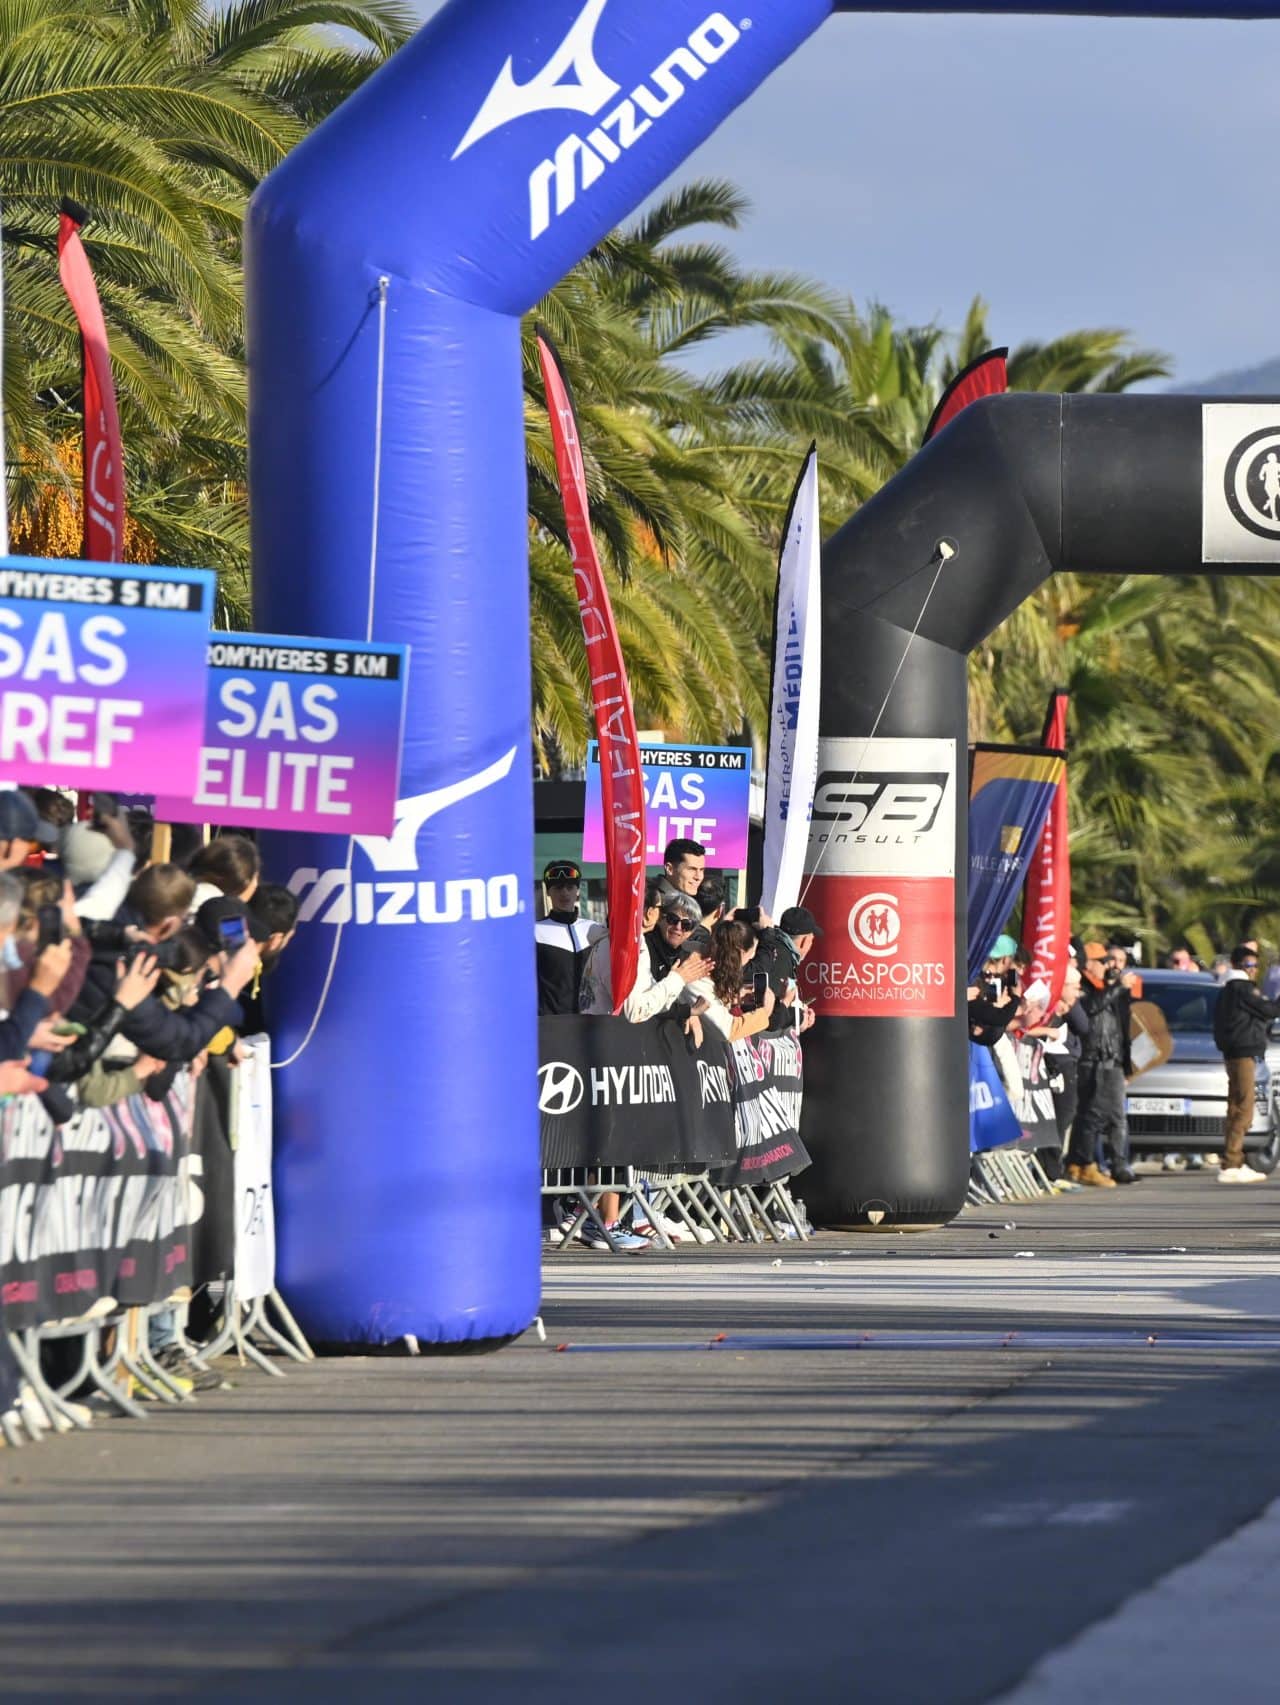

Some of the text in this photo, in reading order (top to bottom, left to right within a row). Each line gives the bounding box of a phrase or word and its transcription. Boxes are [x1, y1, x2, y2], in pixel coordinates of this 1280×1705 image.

[529, 12, 741, 241] MIZUNO
[120, 582, 140, 606] 5
[145, 583, 189, 610] KM
[333, 656, 349, 676] 5
[354, 655, 388, 678] KM
[217, 677, 338, 743] SAS
[698, 752, 714, 768] 10
[719, 753, 742, 769] KM
[193, 746, 354, 815] ELITE
[286, 865, 519, 925] MIZUNO
[805, 963, 945, 986] CREASPORTS
[824, 987, 926, 1001] ORGANISATION
[591, 1065, 676, 1106] HYUNDAI
